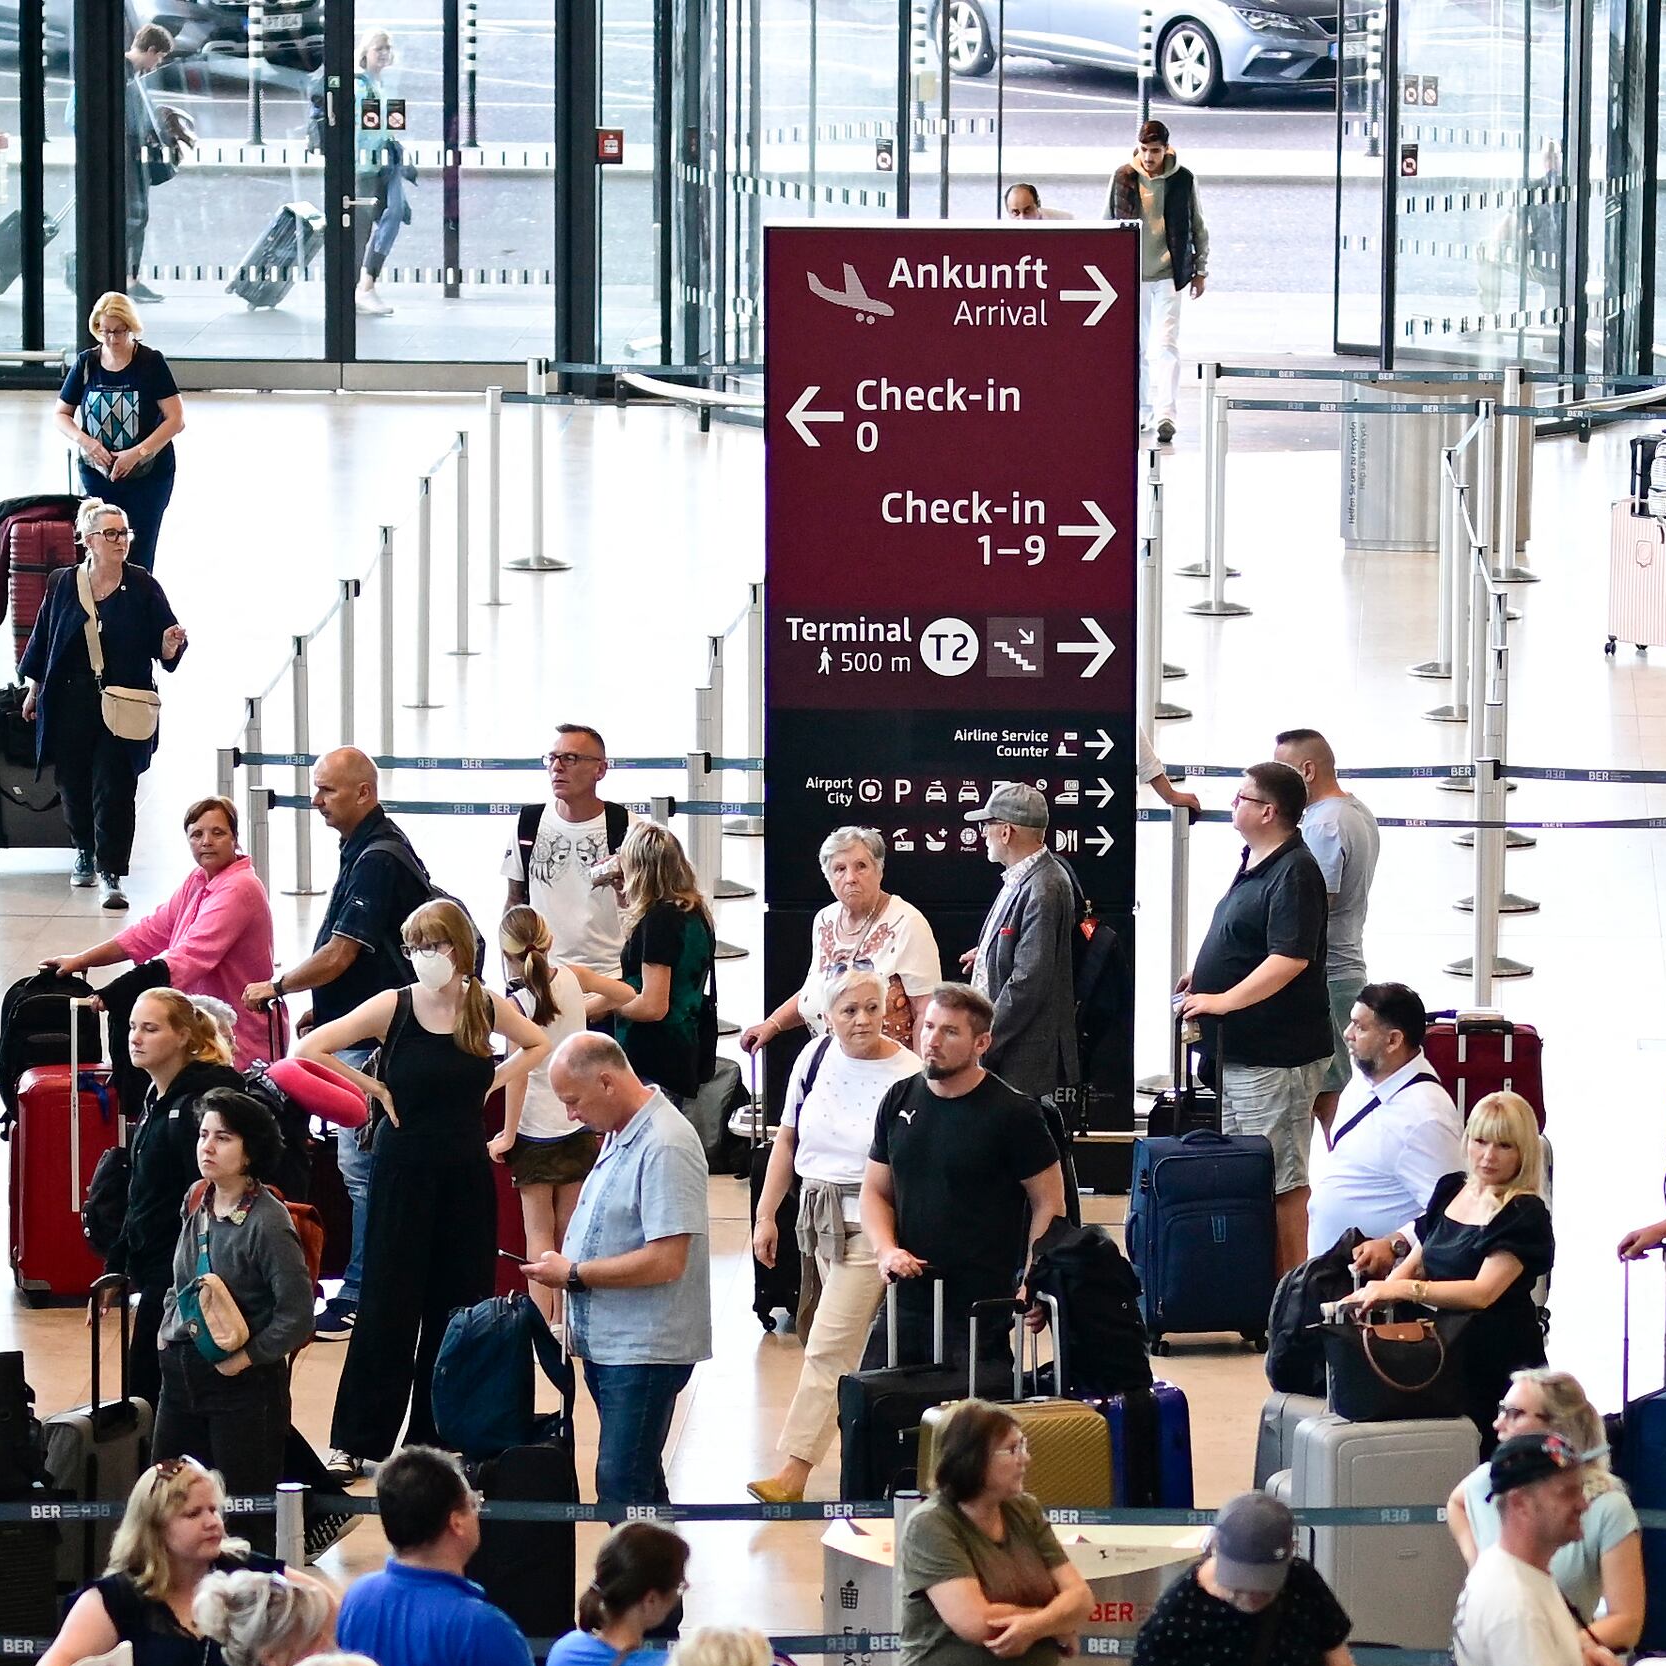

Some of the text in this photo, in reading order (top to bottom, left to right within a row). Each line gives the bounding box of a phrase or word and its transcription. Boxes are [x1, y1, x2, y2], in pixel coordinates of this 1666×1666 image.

[889, 256, 1049, 289] Ankunft
[953, 300, 1048, 327] Arrival
[855, 378, 1021, 413] Check-in
[855, 421, 879, 453] 0
[881, 491, 1046, 525] Check-in
[786, 616, 970, 661] Terminal T2
[840, 651, 911, 674] 500 m
[954, 729, 1049, 742] Airline Service
[996, 745, 1049, 757] Counter
[461, 759, 482, 768] BER
[1185, 765, 1206, 775] BER
[1450, 767, 1471, 777] BER
[1588, 770, 1609, 781] BER
[805, 775, 853, 793] Airport
[827, 790, 853, 806] City
[490, 804, 510, 813] BER
[625, 803, 645, 813] BER
[1054, 1087, 1076, 1103] ER
[31, 1504, 61, 1519] BER
[225, 1498, 253, 1513] BER
[824, 1503, 853, 1518] BER
[627, 1506, 657, 1521] BER
[1049, 1510, 1079, 1524] BER
[1088, 1602, 1134, 1622] BER
[3, 1639, 34, 1653] BER
[869, 1635, 900, 1650] BER
[1087, 1637, 1120, 1654] BER
